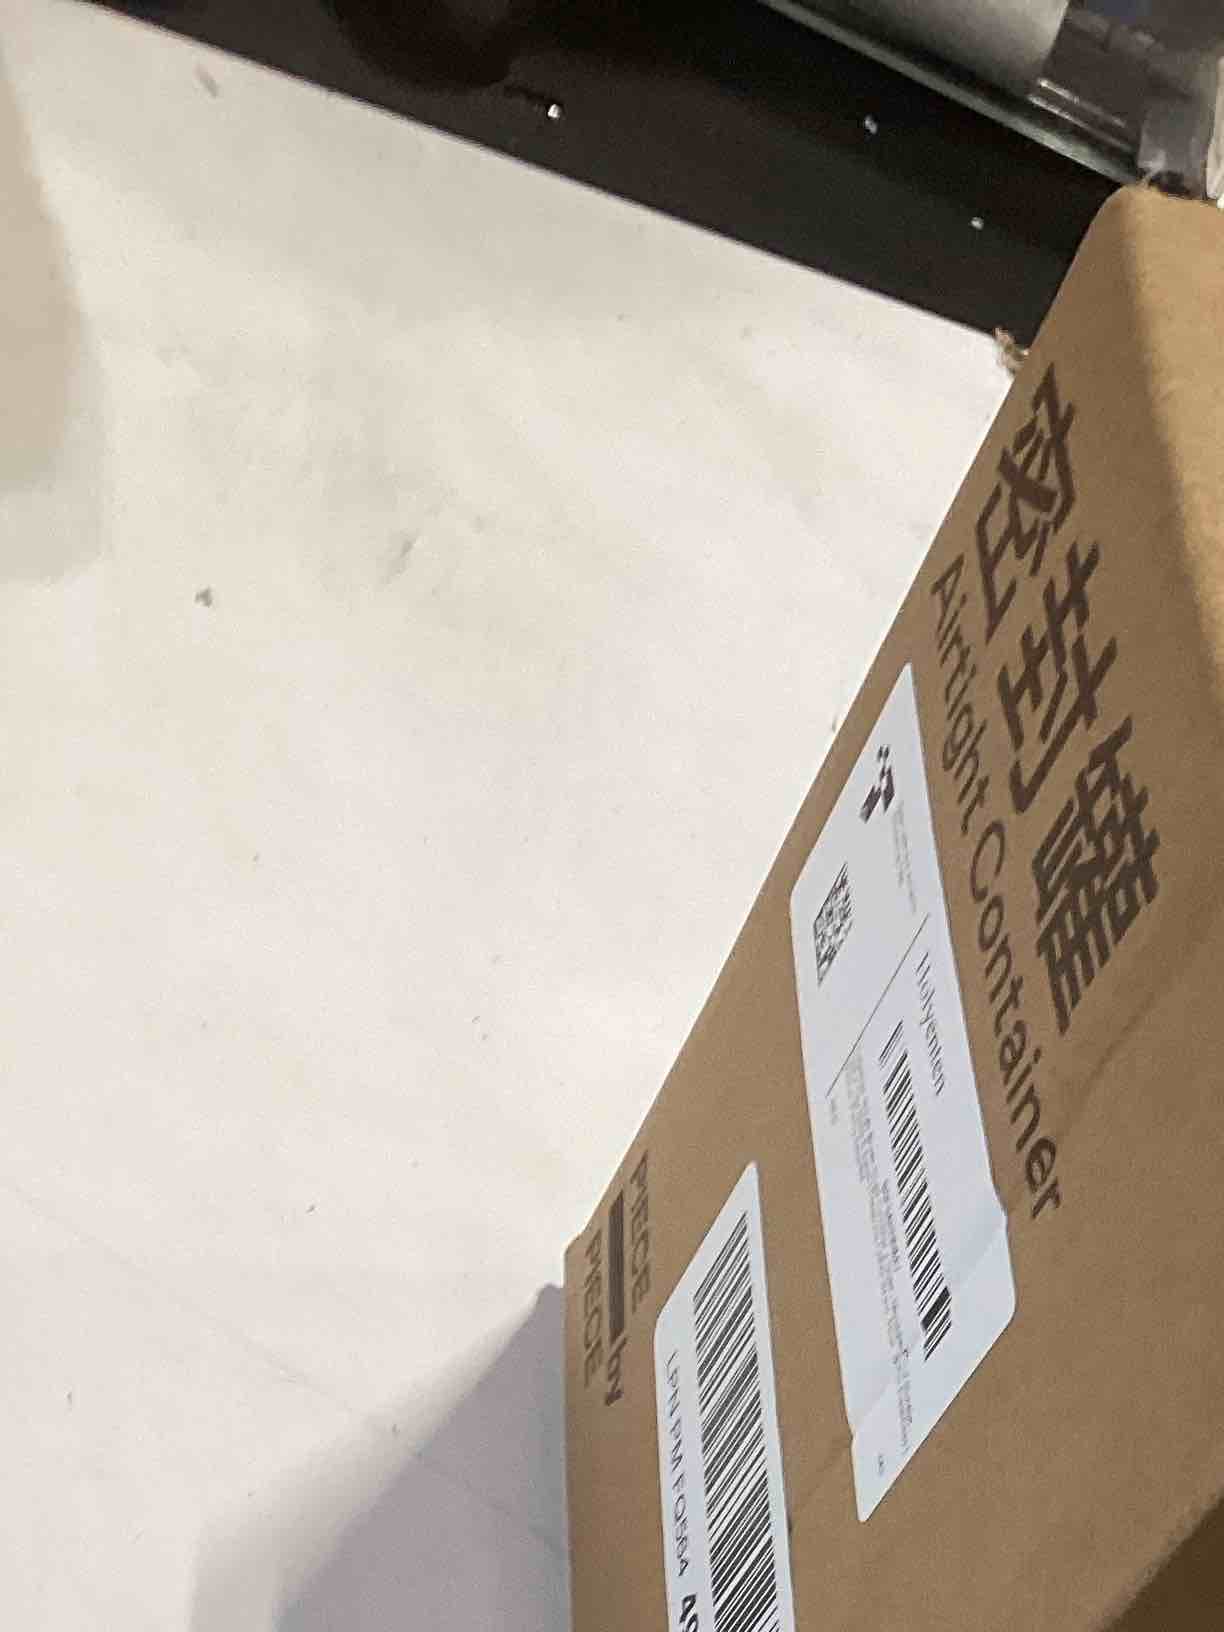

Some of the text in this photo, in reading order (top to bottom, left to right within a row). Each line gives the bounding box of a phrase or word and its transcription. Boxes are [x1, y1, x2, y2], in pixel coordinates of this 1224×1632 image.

[931, 552, 1061, 1221] Airtight Container
[974, 361, 1161, 1036] 密封罐
